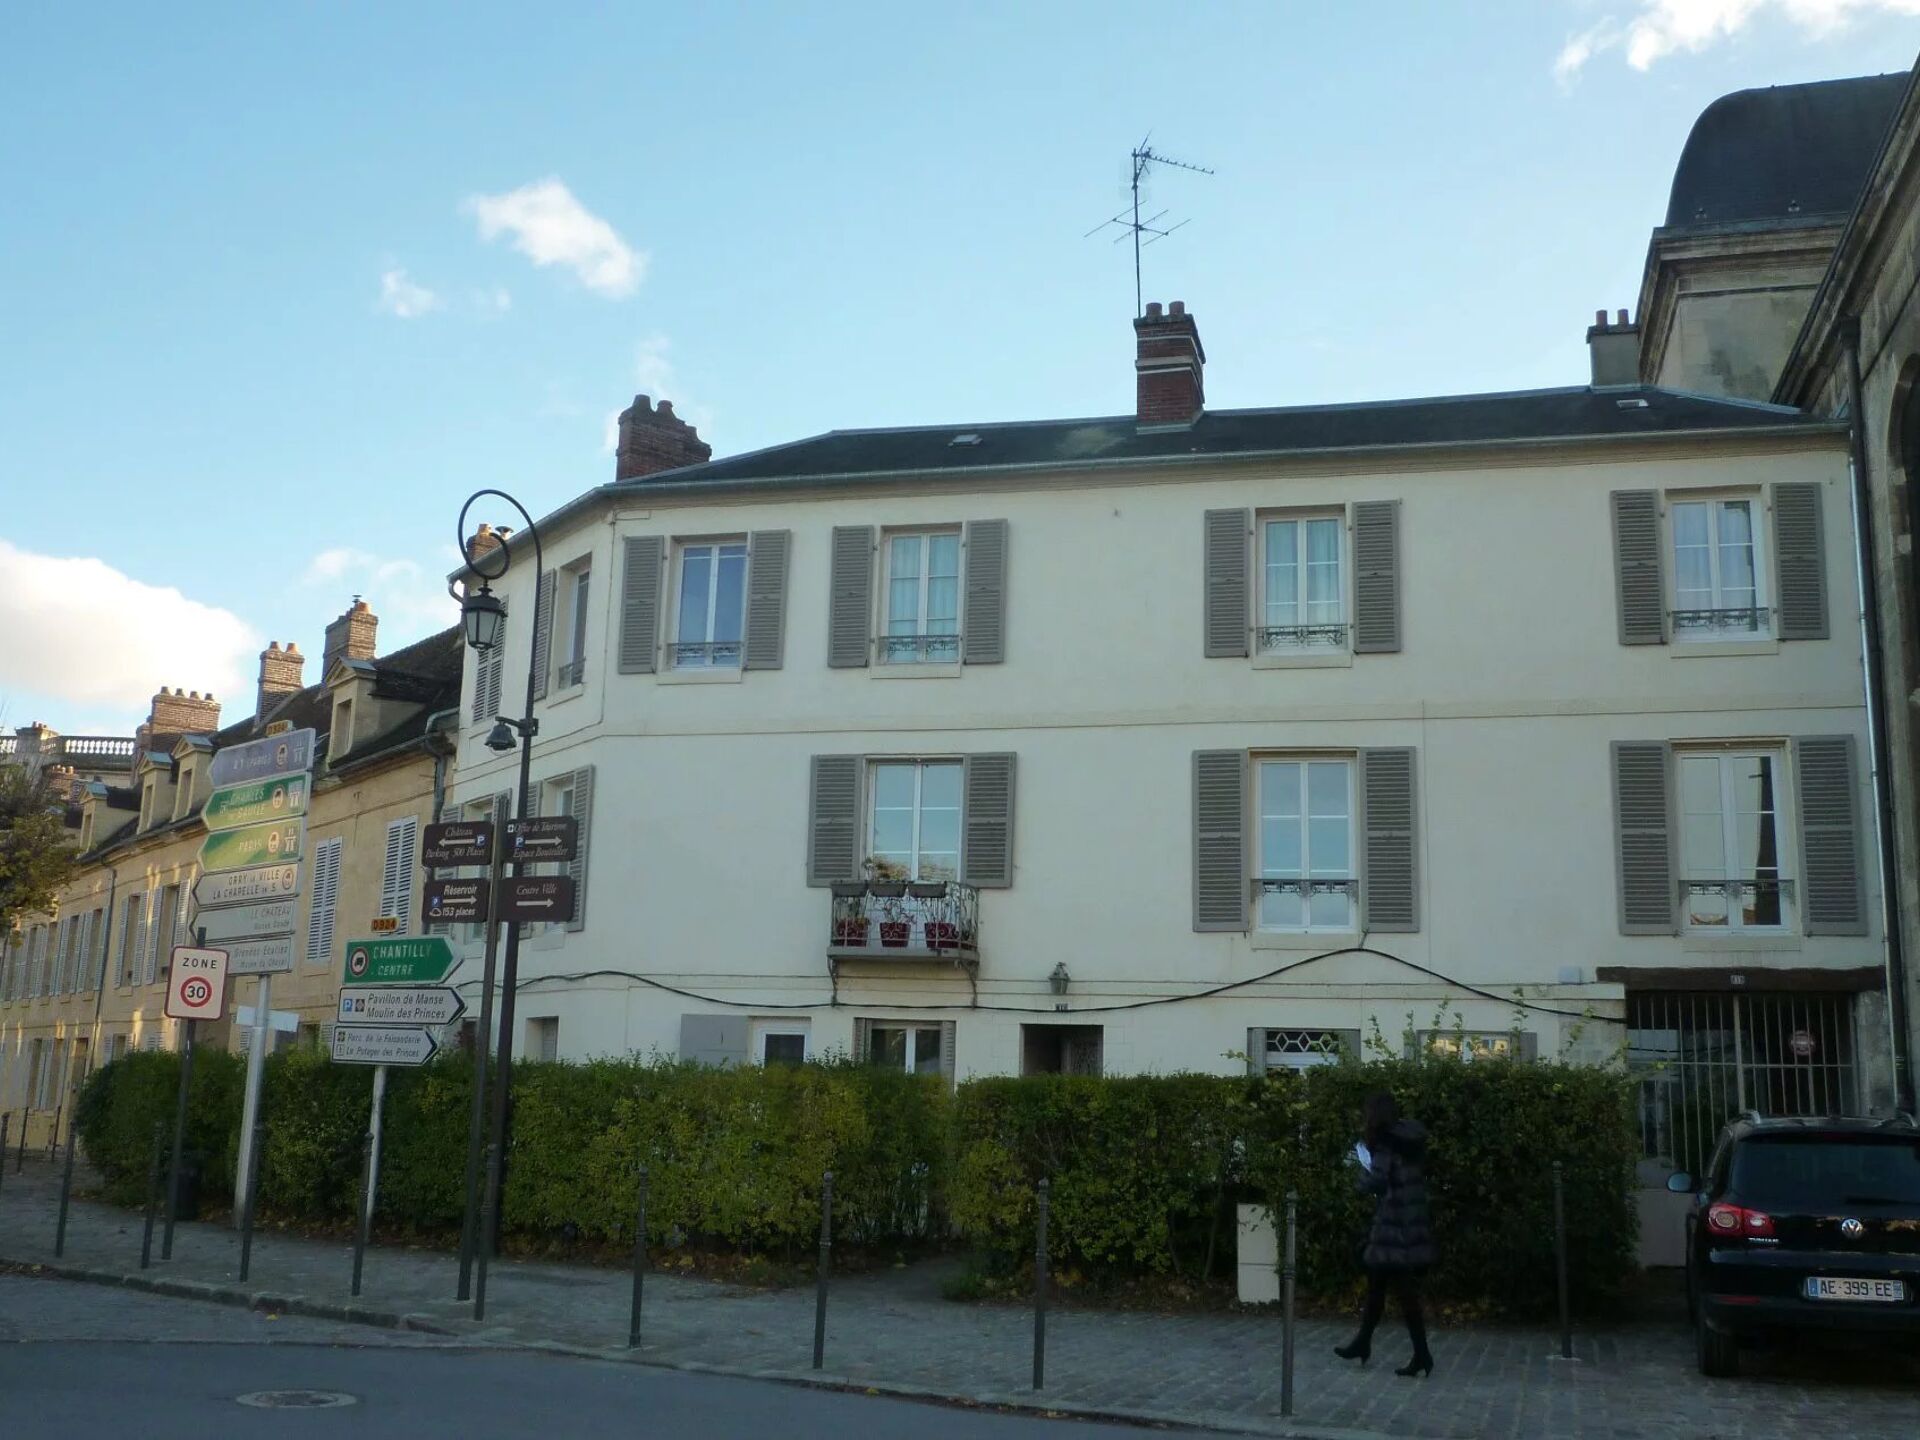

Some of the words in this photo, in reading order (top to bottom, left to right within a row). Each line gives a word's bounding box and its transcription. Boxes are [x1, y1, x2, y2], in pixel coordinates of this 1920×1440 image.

[259, 869, 281, 881] VILLE
[224, 884, 259, 898] CHAPELLE
[443, 883, 478, 895] Réservoir
[442, 908, 455, 916] 153
[454, 907, 476, 918] places
[372, 917, 397, 931] D924
[372, 943, 432, 960] CHANTILLY
[182, 957, 217, 969] ZONE
[377, 964, 415, 977] CENTRE
[186, 985, 206, 999] 30
[368, 993, 401, 1005] Pavillon
[402, 993, 414, 1005] de
[415, 994, 444, 1005] Manse
[366, 1007, 395, 1018] Moulin
[396, 1007, 412, 1018] des
[413, 1007, 446, 1020] Princes
